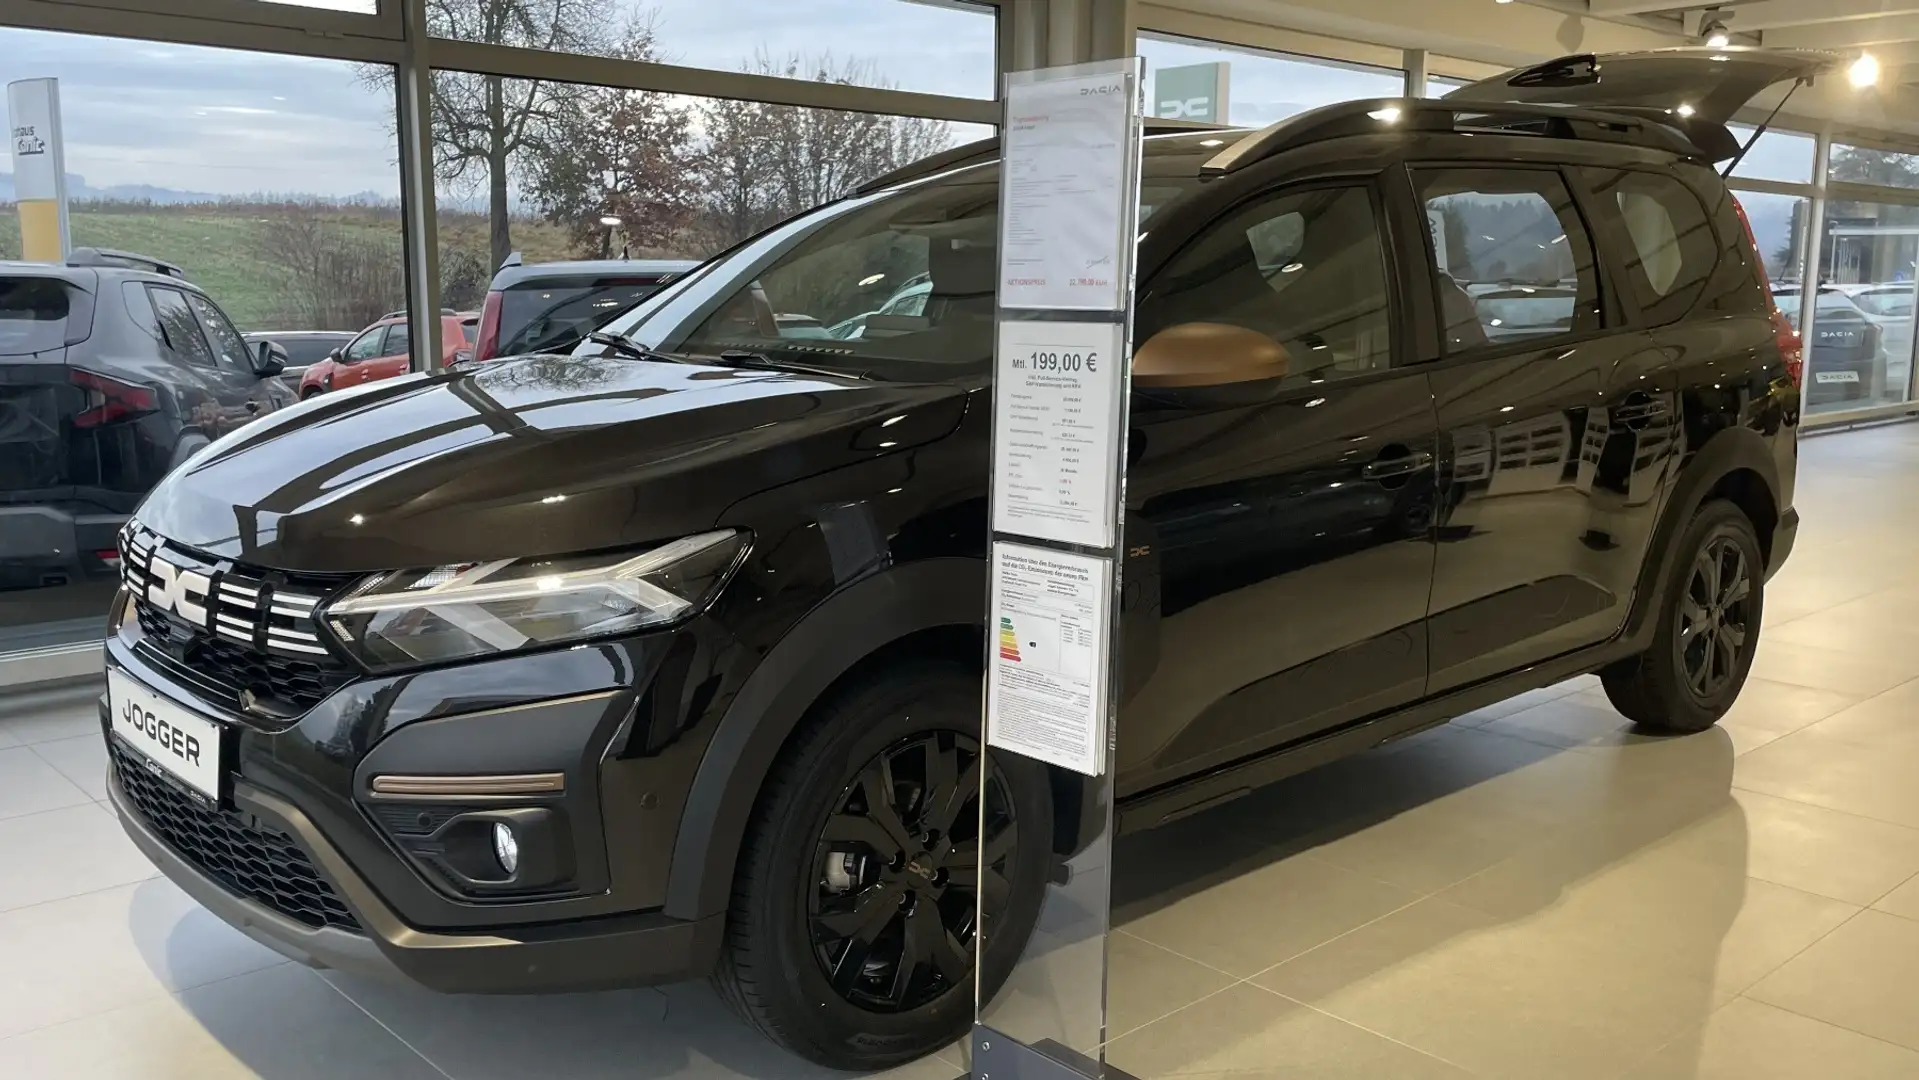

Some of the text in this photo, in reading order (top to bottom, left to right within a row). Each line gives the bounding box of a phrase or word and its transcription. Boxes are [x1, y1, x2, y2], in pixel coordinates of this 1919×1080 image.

[1080, 85, 1121, 96] DACIA
[1012, 352, 1098, 374] Mtl. 199,00 €
[1002, 554, 1028, 563] Information
[122, 698, 200, 768] JOGGER
